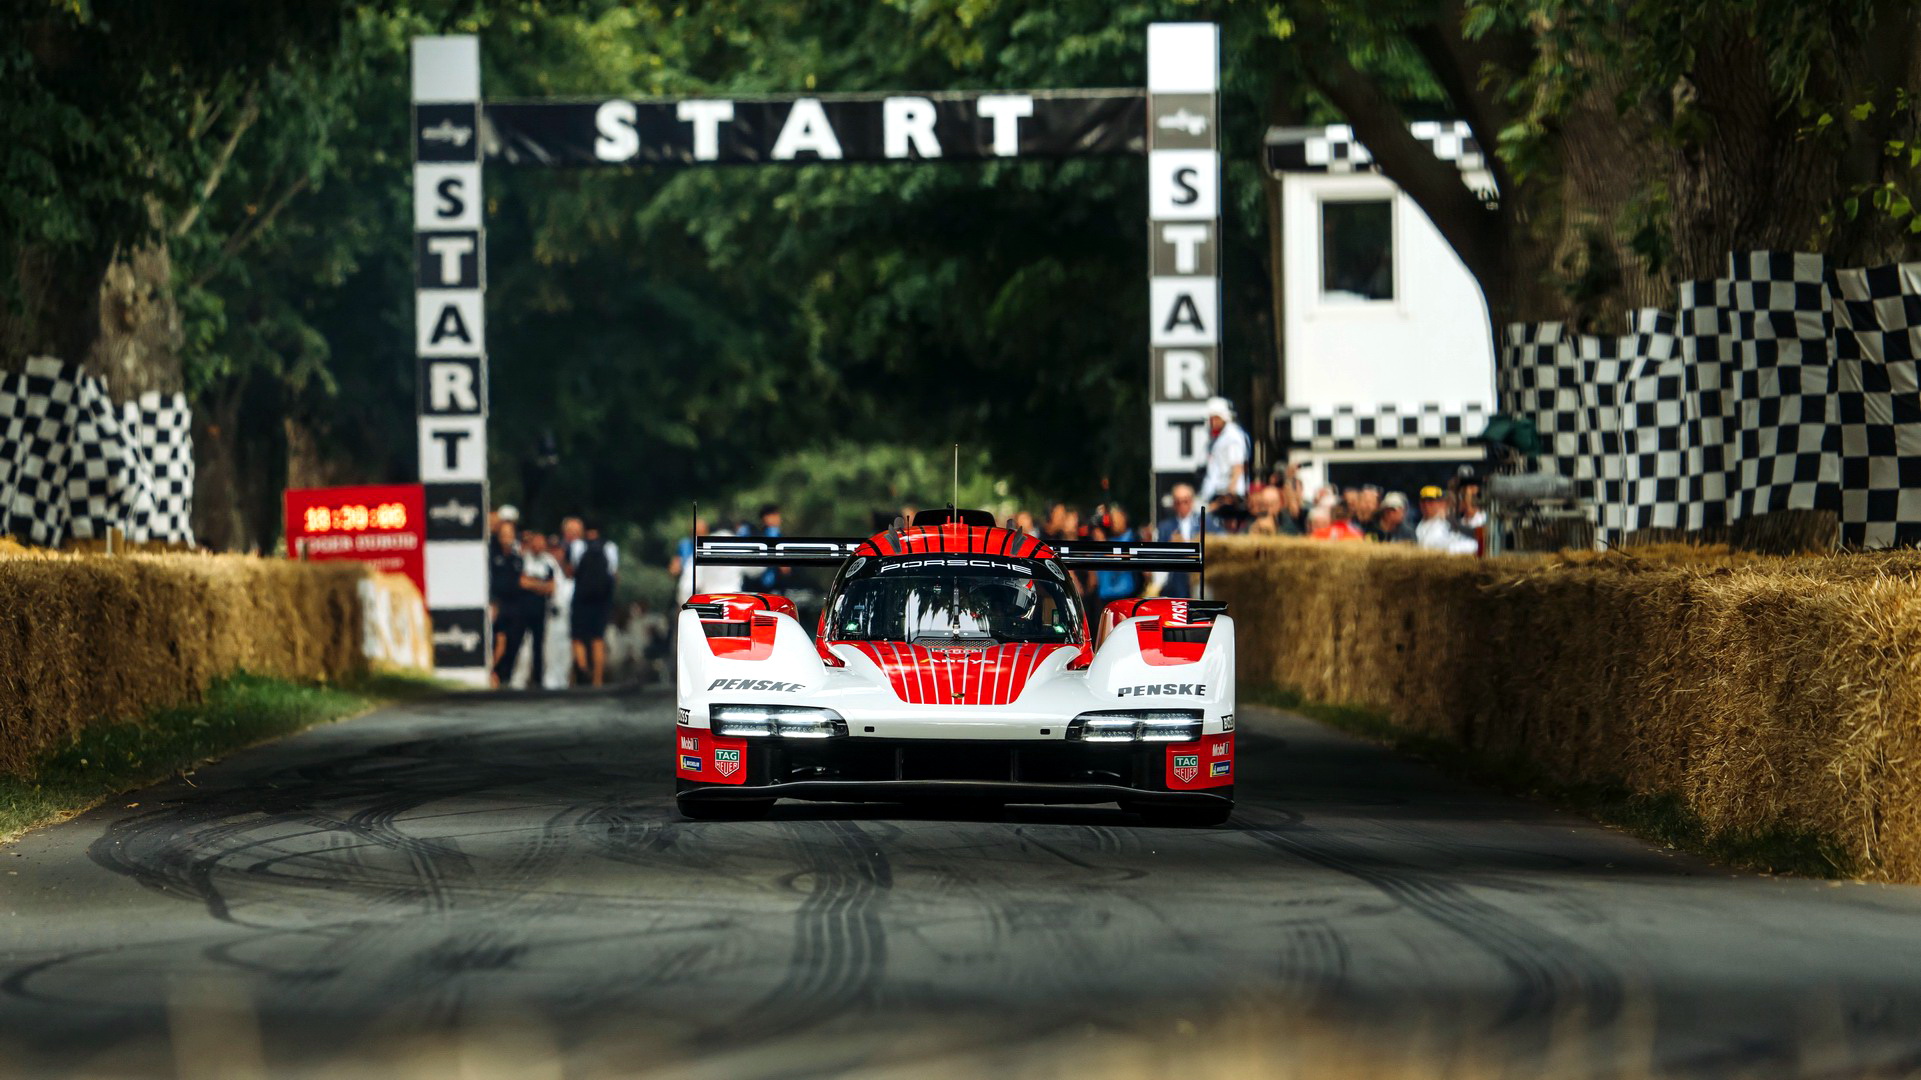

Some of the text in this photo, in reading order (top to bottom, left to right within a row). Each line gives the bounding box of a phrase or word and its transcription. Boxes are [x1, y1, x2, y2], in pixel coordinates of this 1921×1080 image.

[593, 95, 1034, 162] START
[1162, 166, 1210, 458] START
[427, 177, 478, 470] START
[880, 559, 1033, 576] PORSCHE
[706, 678, 806, 693] PENSKE
[1117, 683, 1207, 698] PENSKE
[716, 751, 738, 760] TAG
[1176, 757, 1197, 766] TAG
[715, 761, 739, 775] HEUER
[1174, 767, 1198, 781] HEUER
